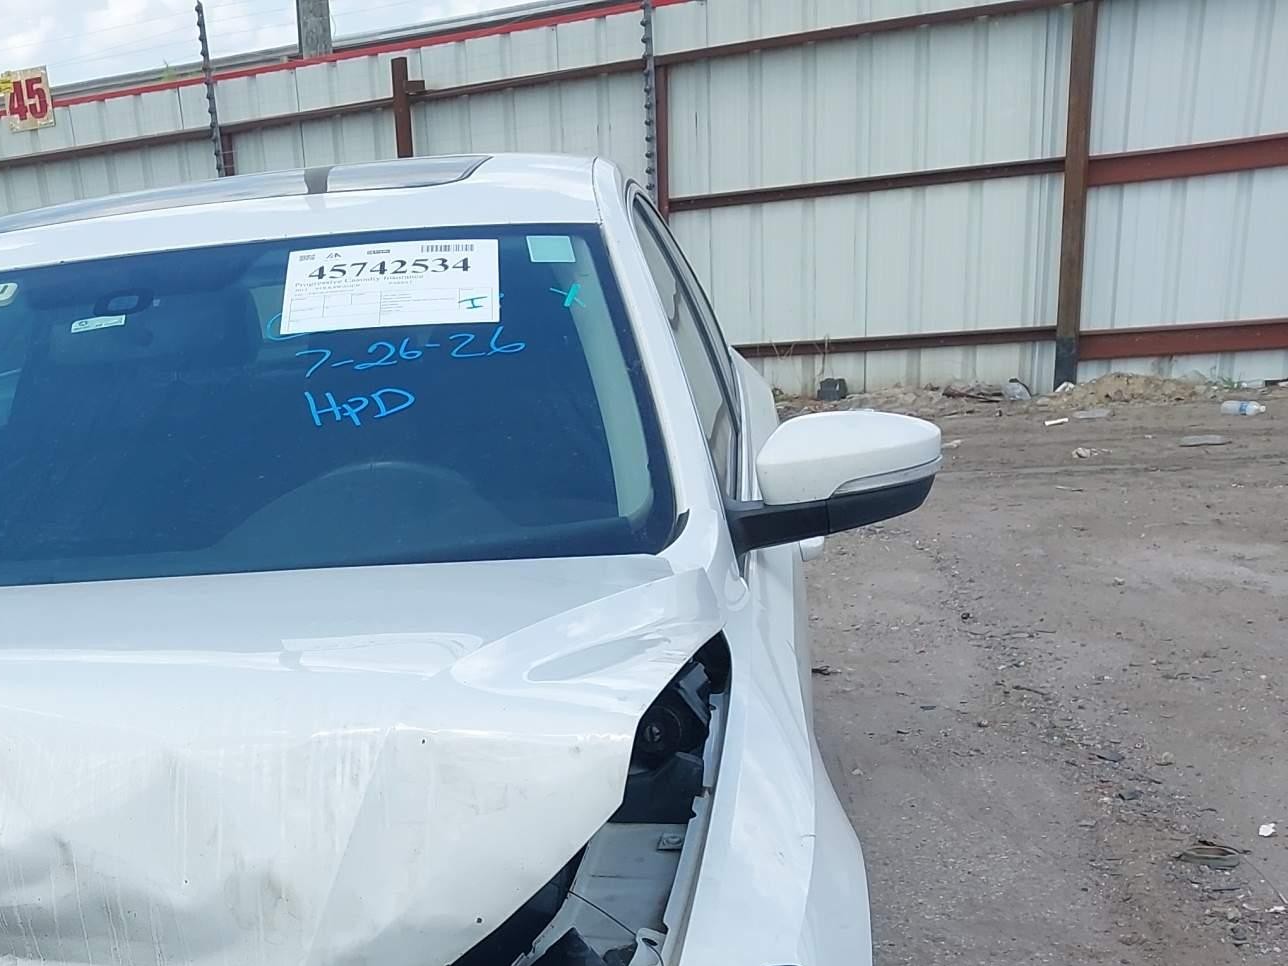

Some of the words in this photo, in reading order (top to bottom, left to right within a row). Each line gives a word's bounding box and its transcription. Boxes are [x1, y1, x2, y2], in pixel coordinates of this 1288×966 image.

[9, 77, 48, 120] 45
[308, 257, 471, 280] 45742534
[295, 326, 526, 378] 7-26-26
